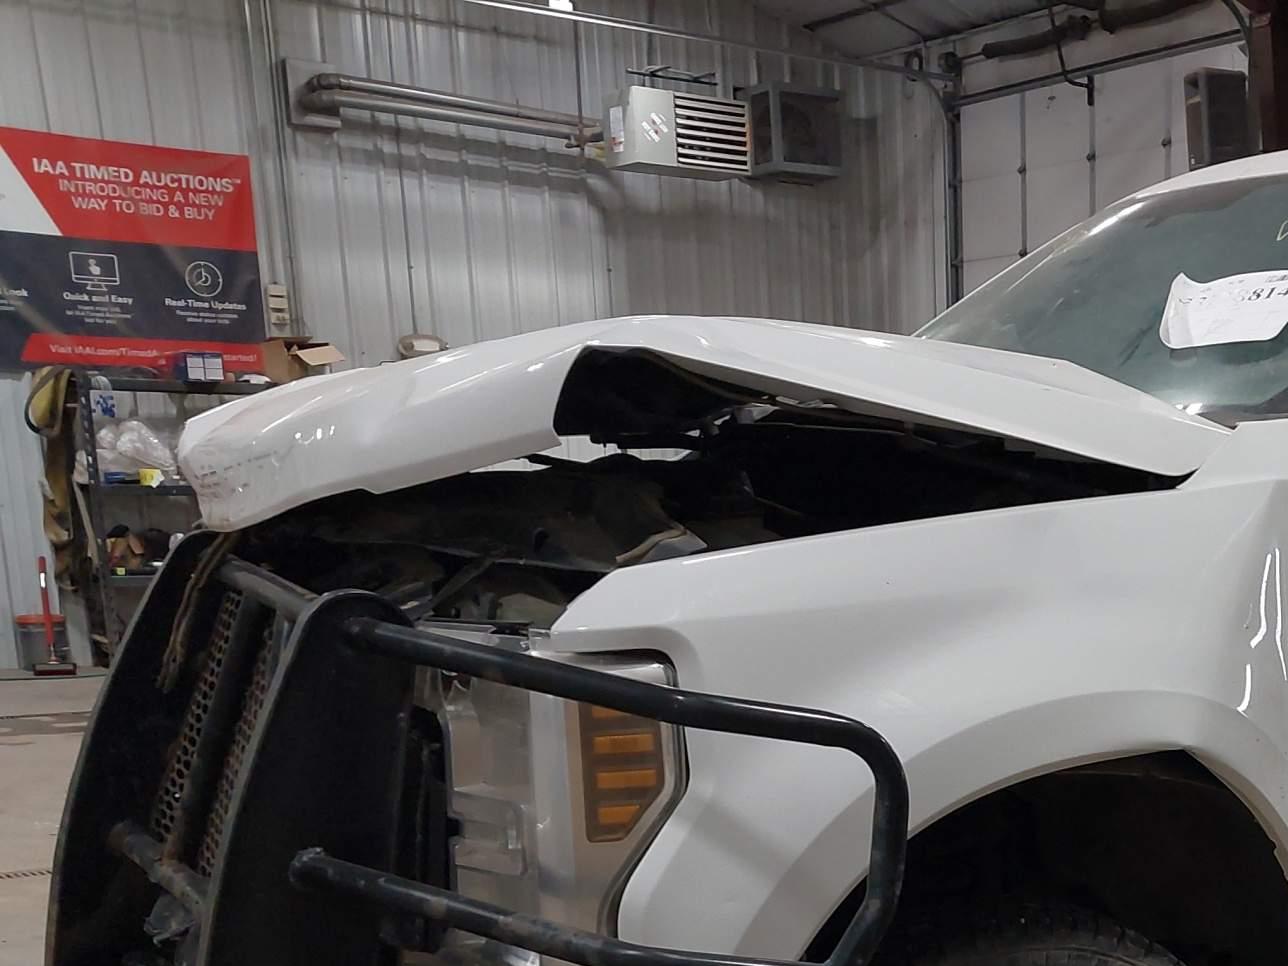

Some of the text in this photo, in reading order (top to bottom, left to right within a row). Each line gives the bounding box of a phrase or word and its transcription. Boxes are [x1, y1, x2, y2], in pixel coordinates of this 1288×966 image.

[32, 157, 68, 176] IAA
[70, 162, 133, 183] TIMED
[59, 179, 224, 207] INTRODUCING A NEW
[71, 196, 216, 221] WAY TO BID & BUY
